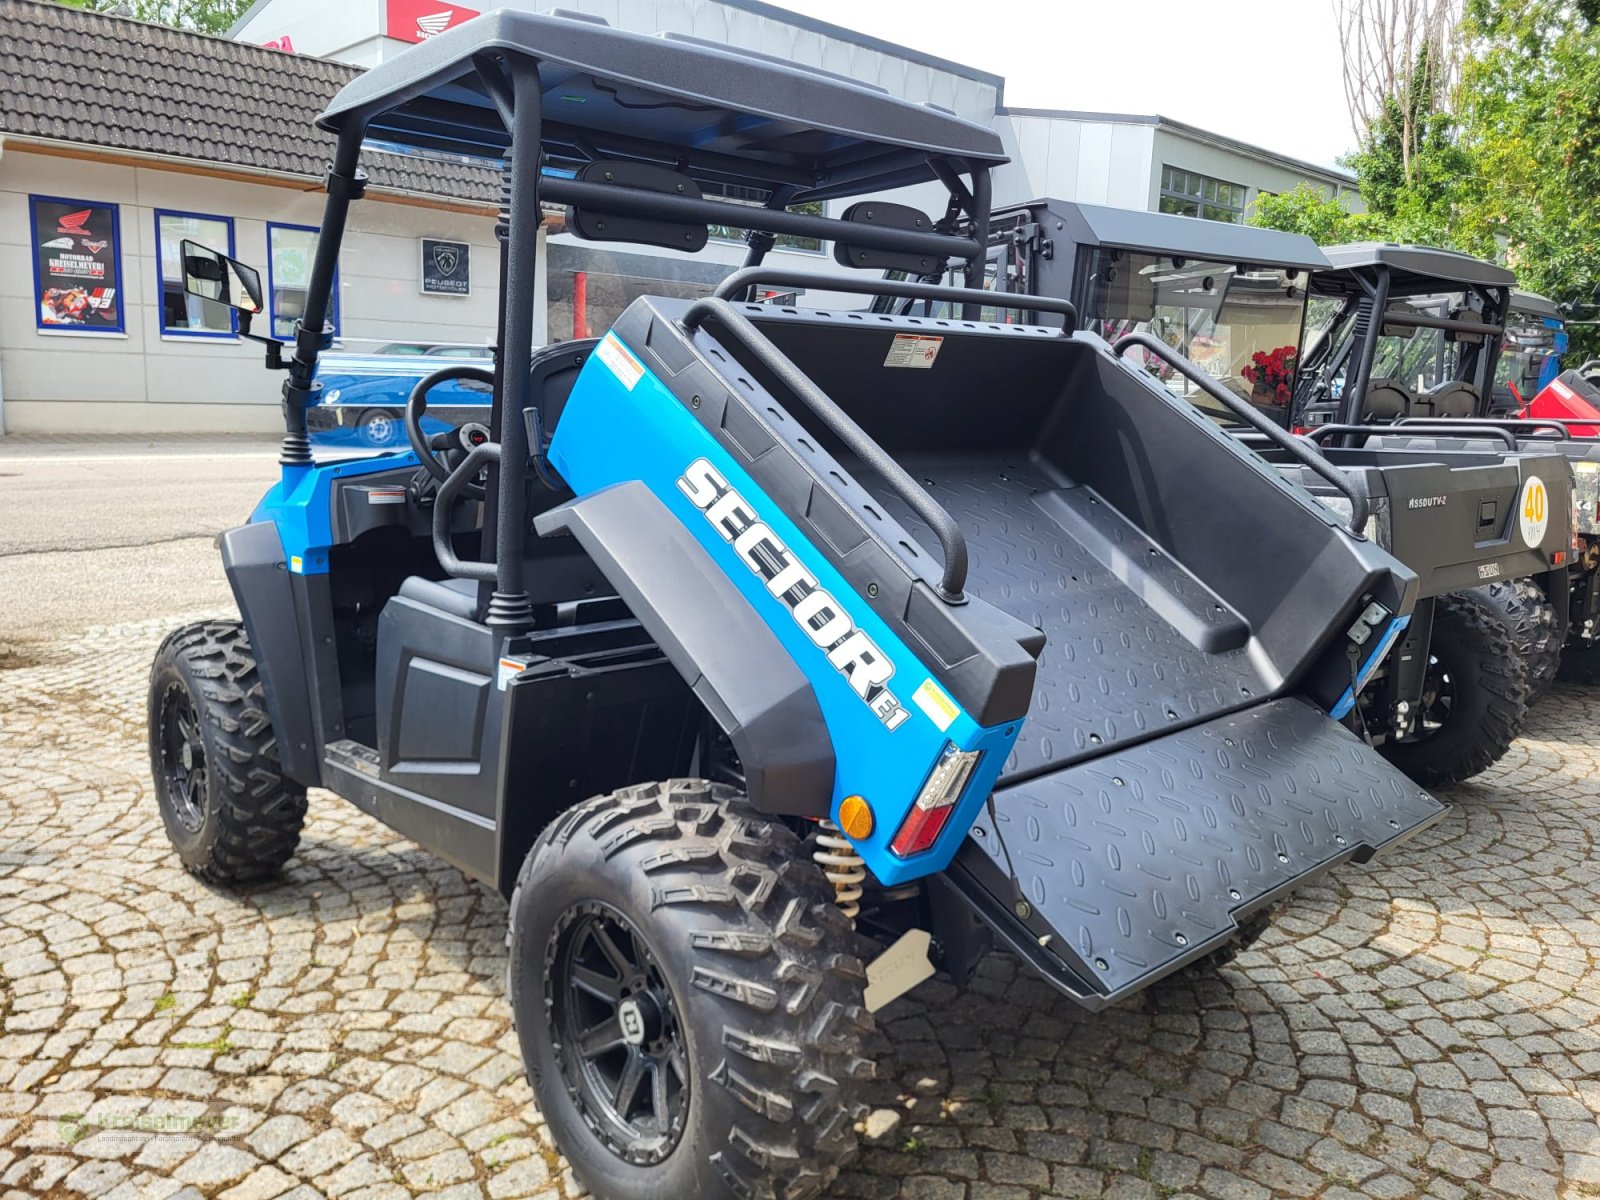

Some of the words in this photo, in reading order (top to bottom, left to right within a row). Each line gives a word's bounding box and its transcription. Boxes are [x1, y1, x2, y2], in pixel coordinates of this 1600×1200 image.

[59, 253, 94, 262] MOTORRAD
[425, 278, 468, 287] PEUGEOT
[1524, 484, 1544, 524] 40
[675, 457, 895, 701] SECTOR
[868, 689, 911, 732] E1
